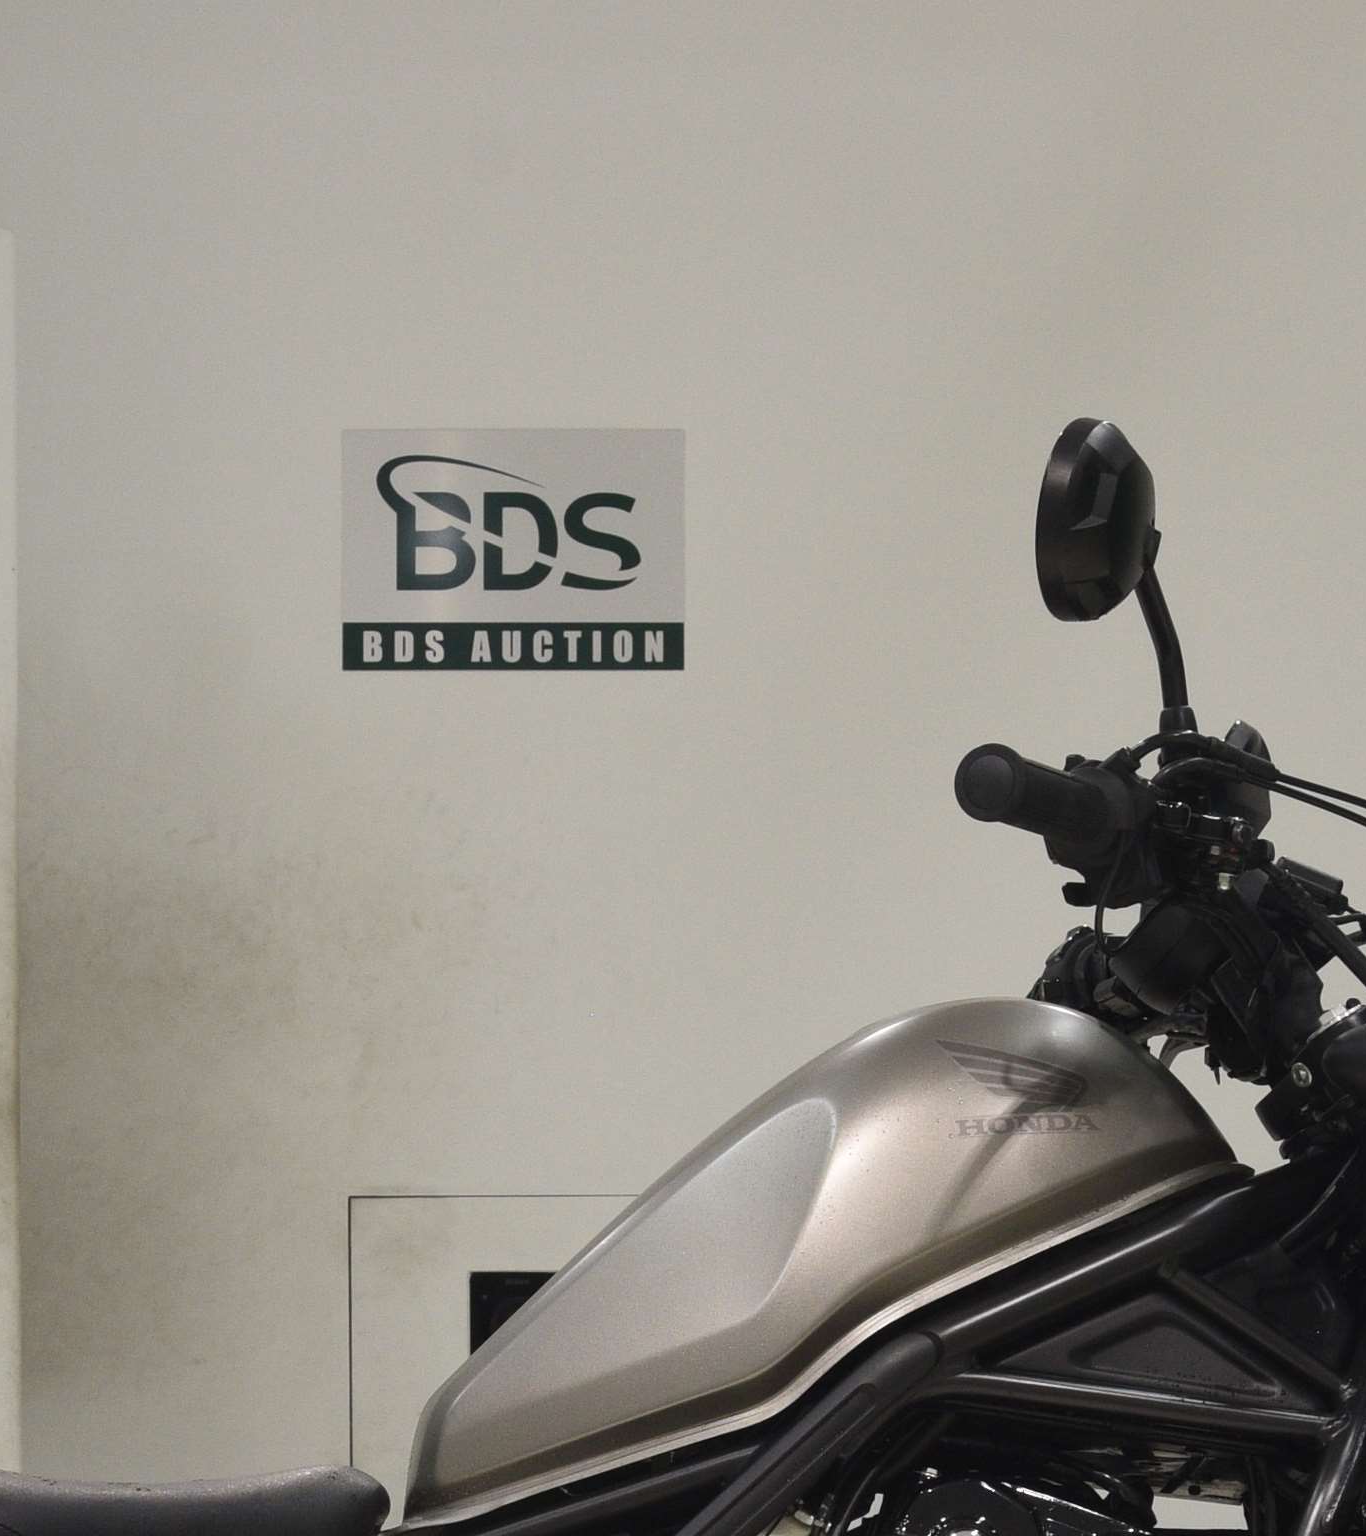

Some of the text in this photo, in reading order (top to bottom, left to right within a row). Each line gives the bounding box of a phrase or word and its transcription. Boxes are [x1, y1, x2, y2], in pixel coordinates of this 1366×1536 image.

[376, 455, 641, 591] BDS
[362, 630, 665, 663] BDS AUCTION
[955, 1111, 1101, 1136] HONDA
